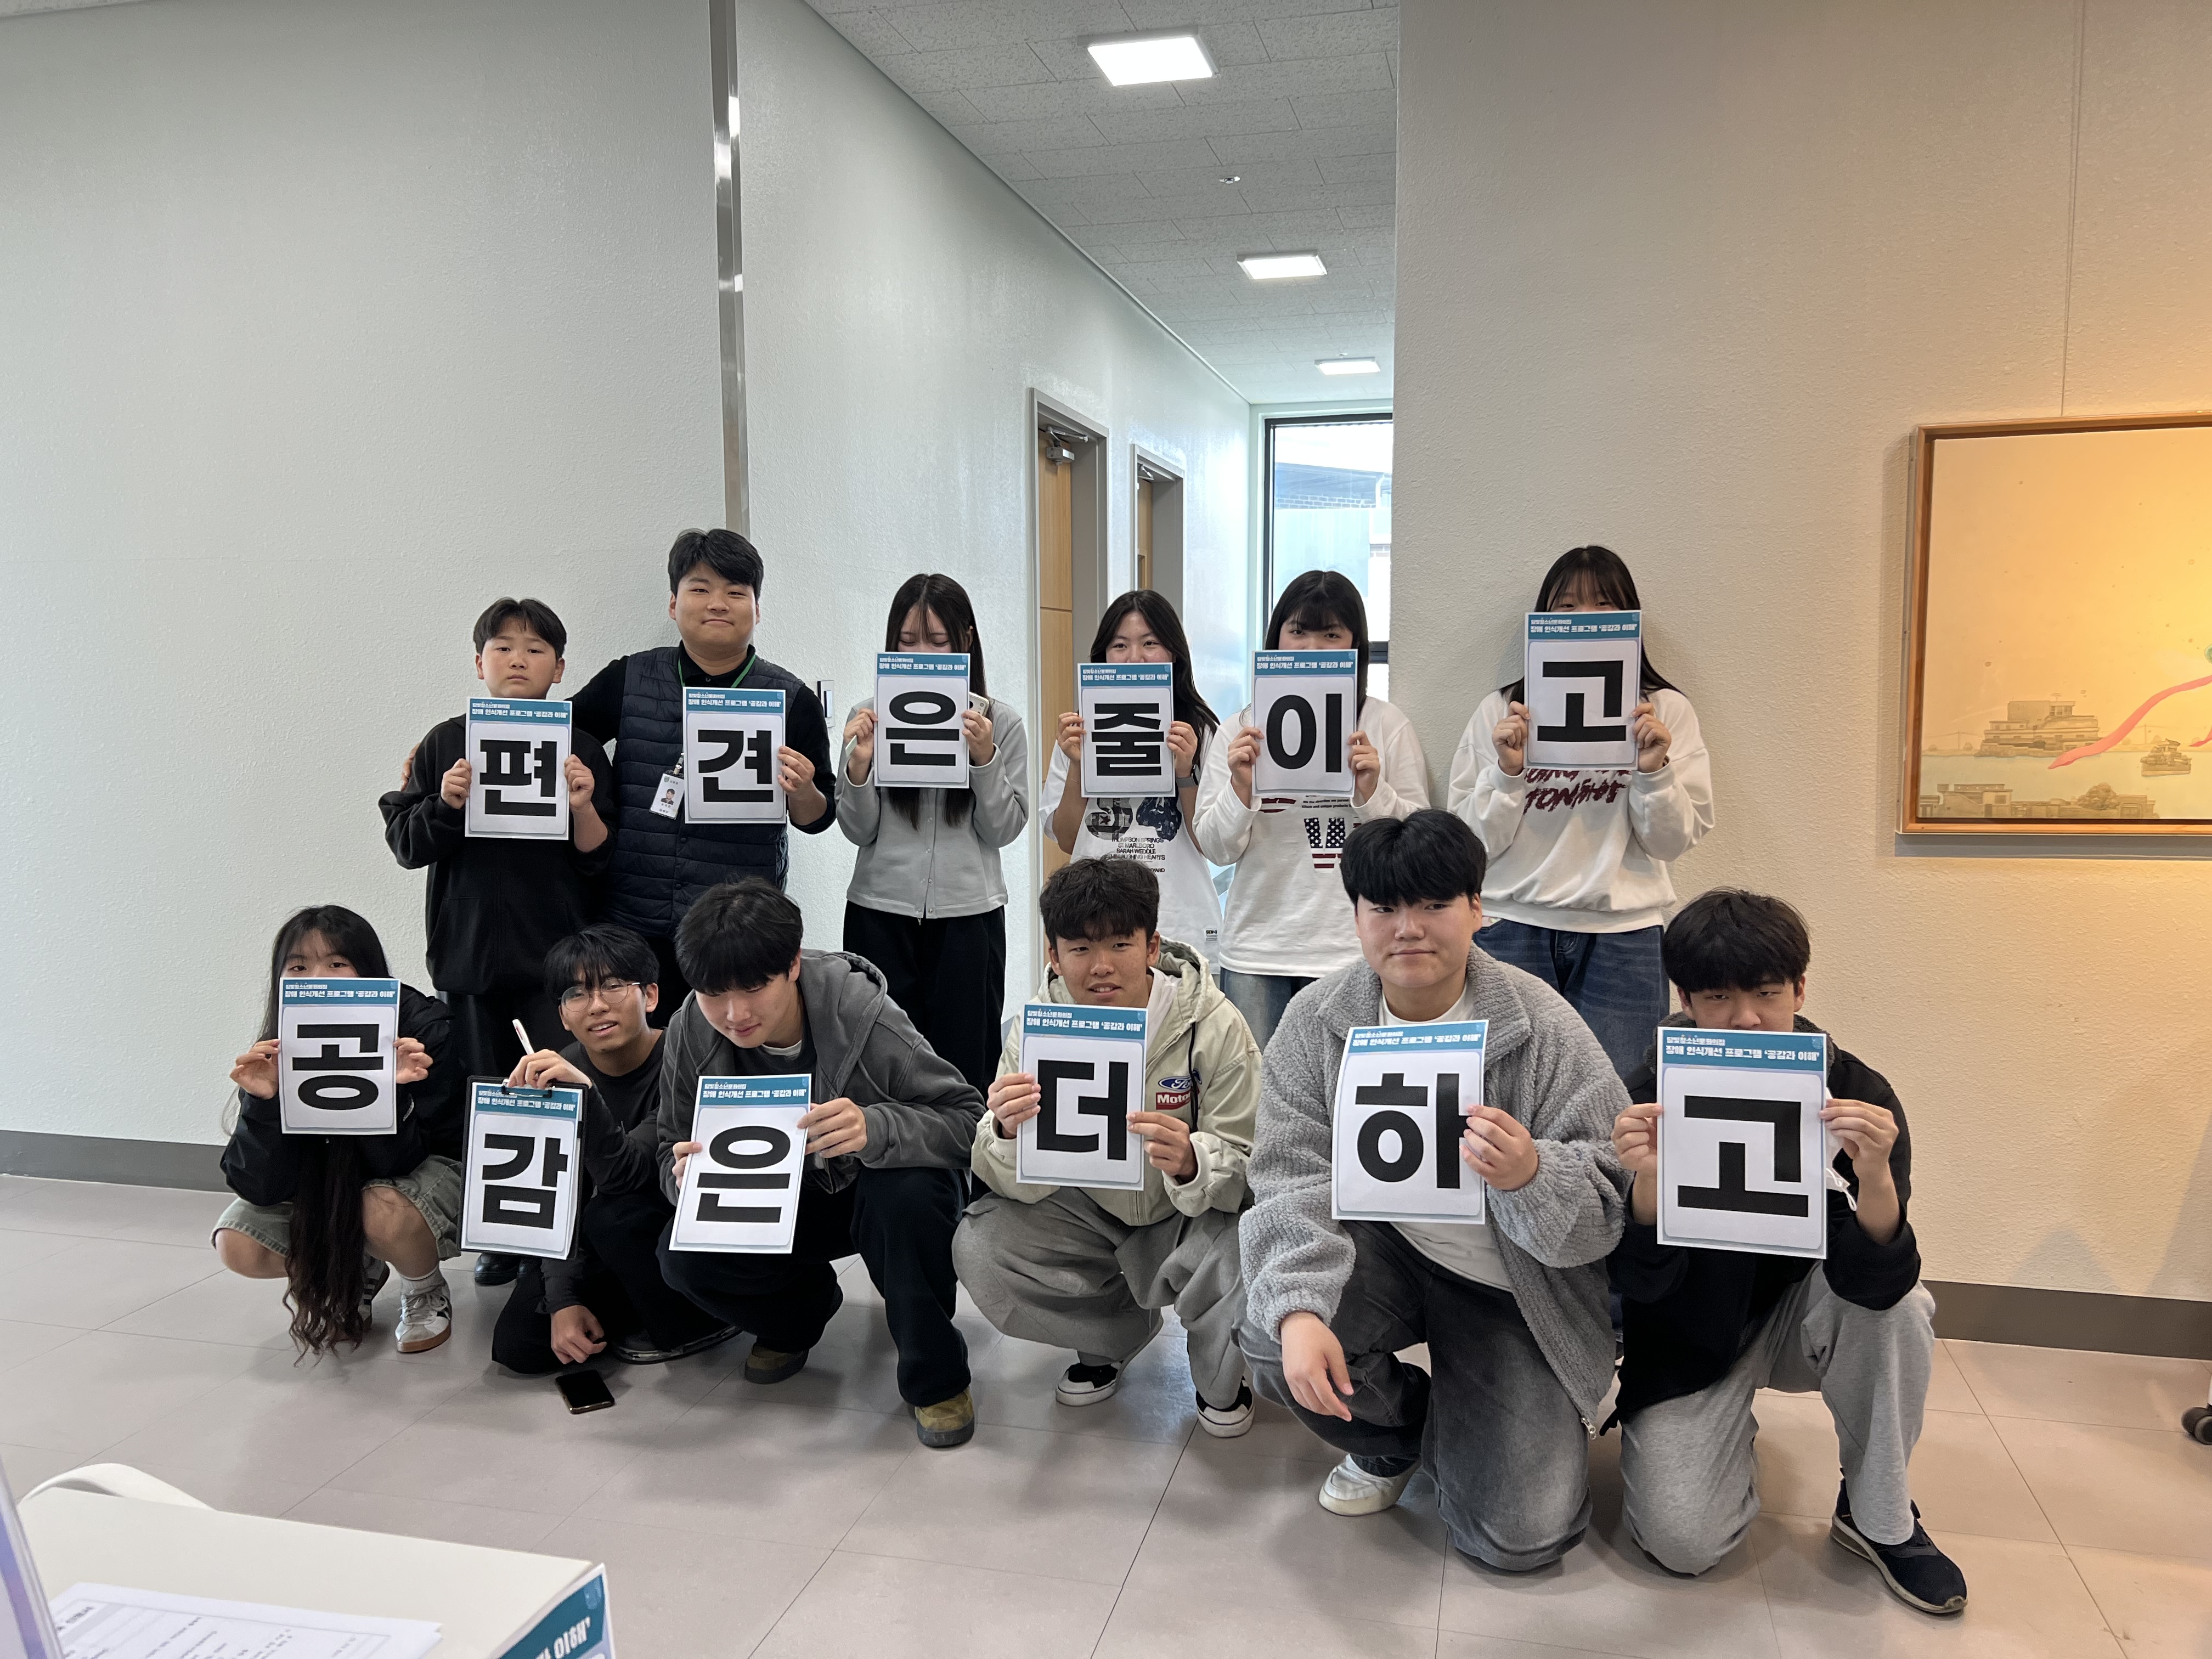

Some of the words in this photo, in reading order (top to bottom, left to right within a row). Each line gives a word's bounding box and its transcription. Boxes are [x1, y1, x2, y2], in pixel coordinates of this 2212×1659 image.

[886, 692, 959, 766] 은
[1092, 703, 1164, 776] 줄
[1267, 694, 1341, 772] 이
[1538, 661, 1626, 742] 고
[480, 740, 556, 816] 편
[698, 730, 773, 802] 견
[1027, 1018, 1040, 1026] 장애
[1042, 1019, 1069, 1027] 인식개선
[1071, 1020, 1099, 1029] 프로그램
[1369, 1037, 1400, 1046] 인식개선
[1401, 1036, 1432, 1044] 프로그램
[1666, 1046, 1684, 1054] 장애
[1687, 1047, 1722, 1057] 인식개선
[1725, 1048, 1762, 1058] 프로그램
[292, 1024, 383, 1110] 공
[1037, 1060, 1128, 1160] 더
[1355, 1073, 1471, 1189] 하
[482, 1134, 568, 1229] 감
[696, 1126, 791, 1223] 은
[1678, 1096, 1808, 1217] 고
